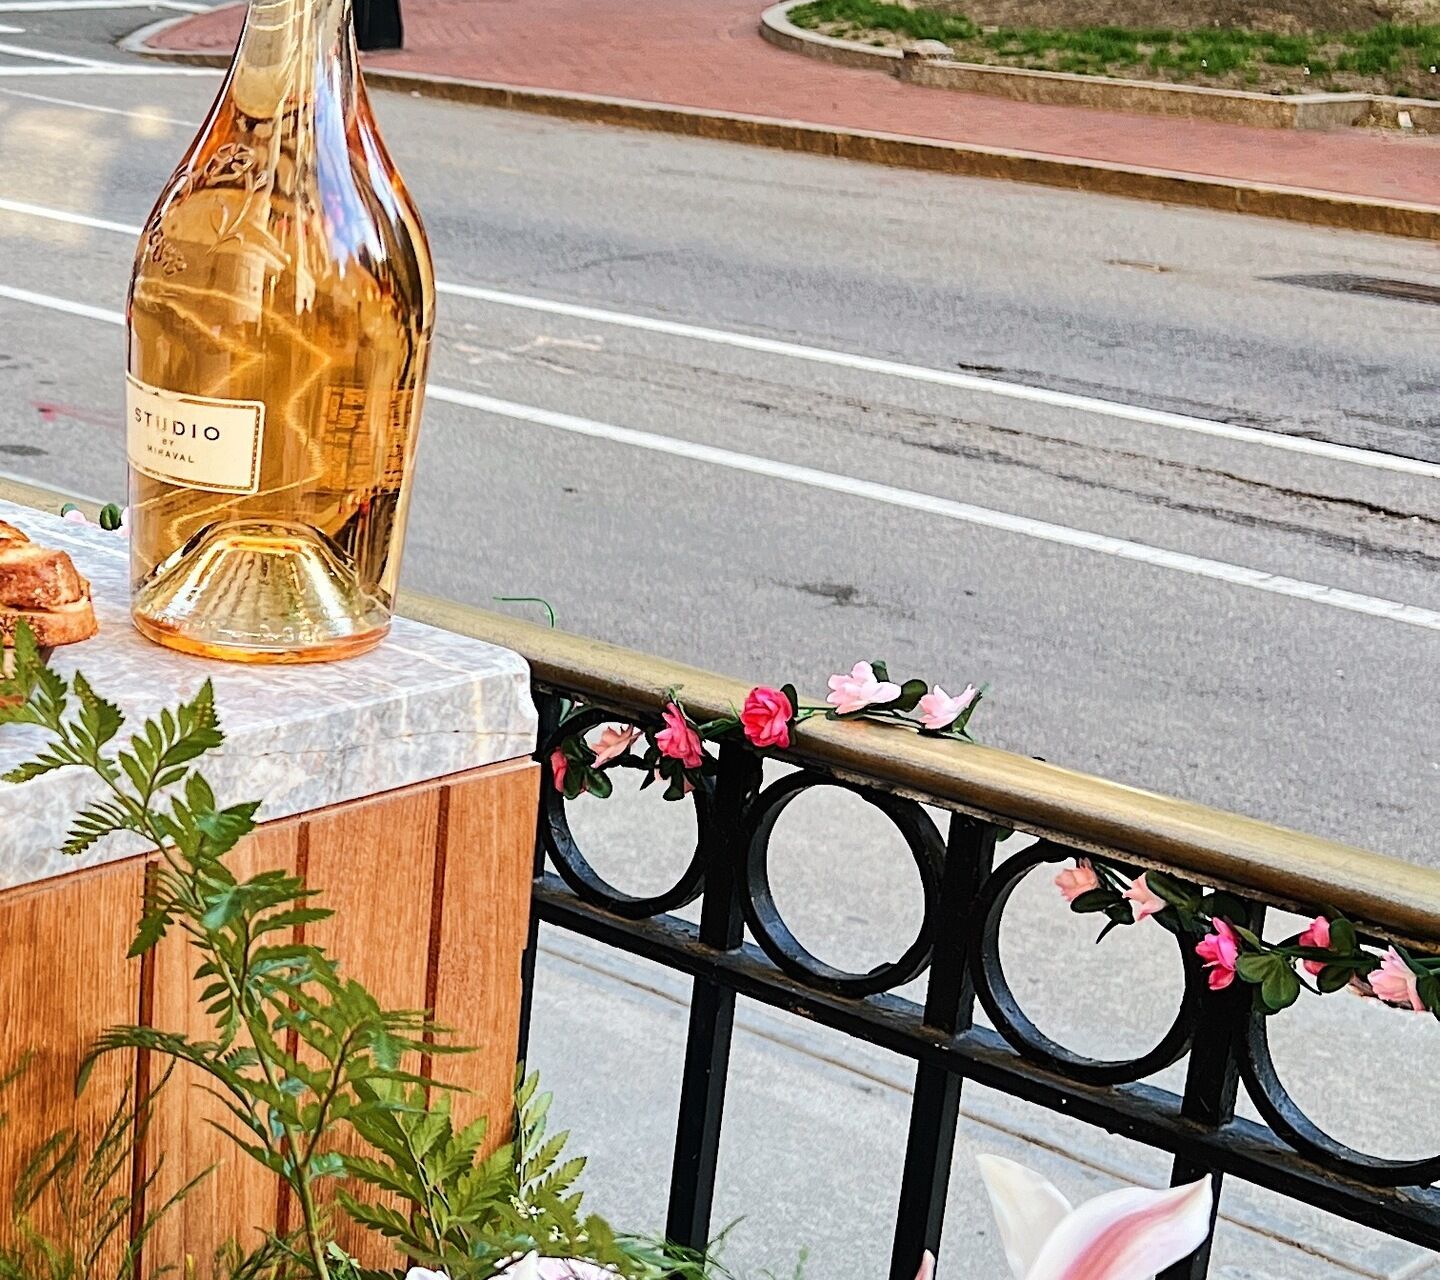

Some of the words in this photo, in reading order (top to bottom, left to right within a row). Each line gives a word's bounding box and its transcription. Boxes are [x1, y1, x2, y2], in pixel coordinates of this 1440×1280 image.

[134, 407, 220, 441] STUDIO
[162, 438, 174, 446] BY
[147, 444, 195, 463] MIRAVAL
